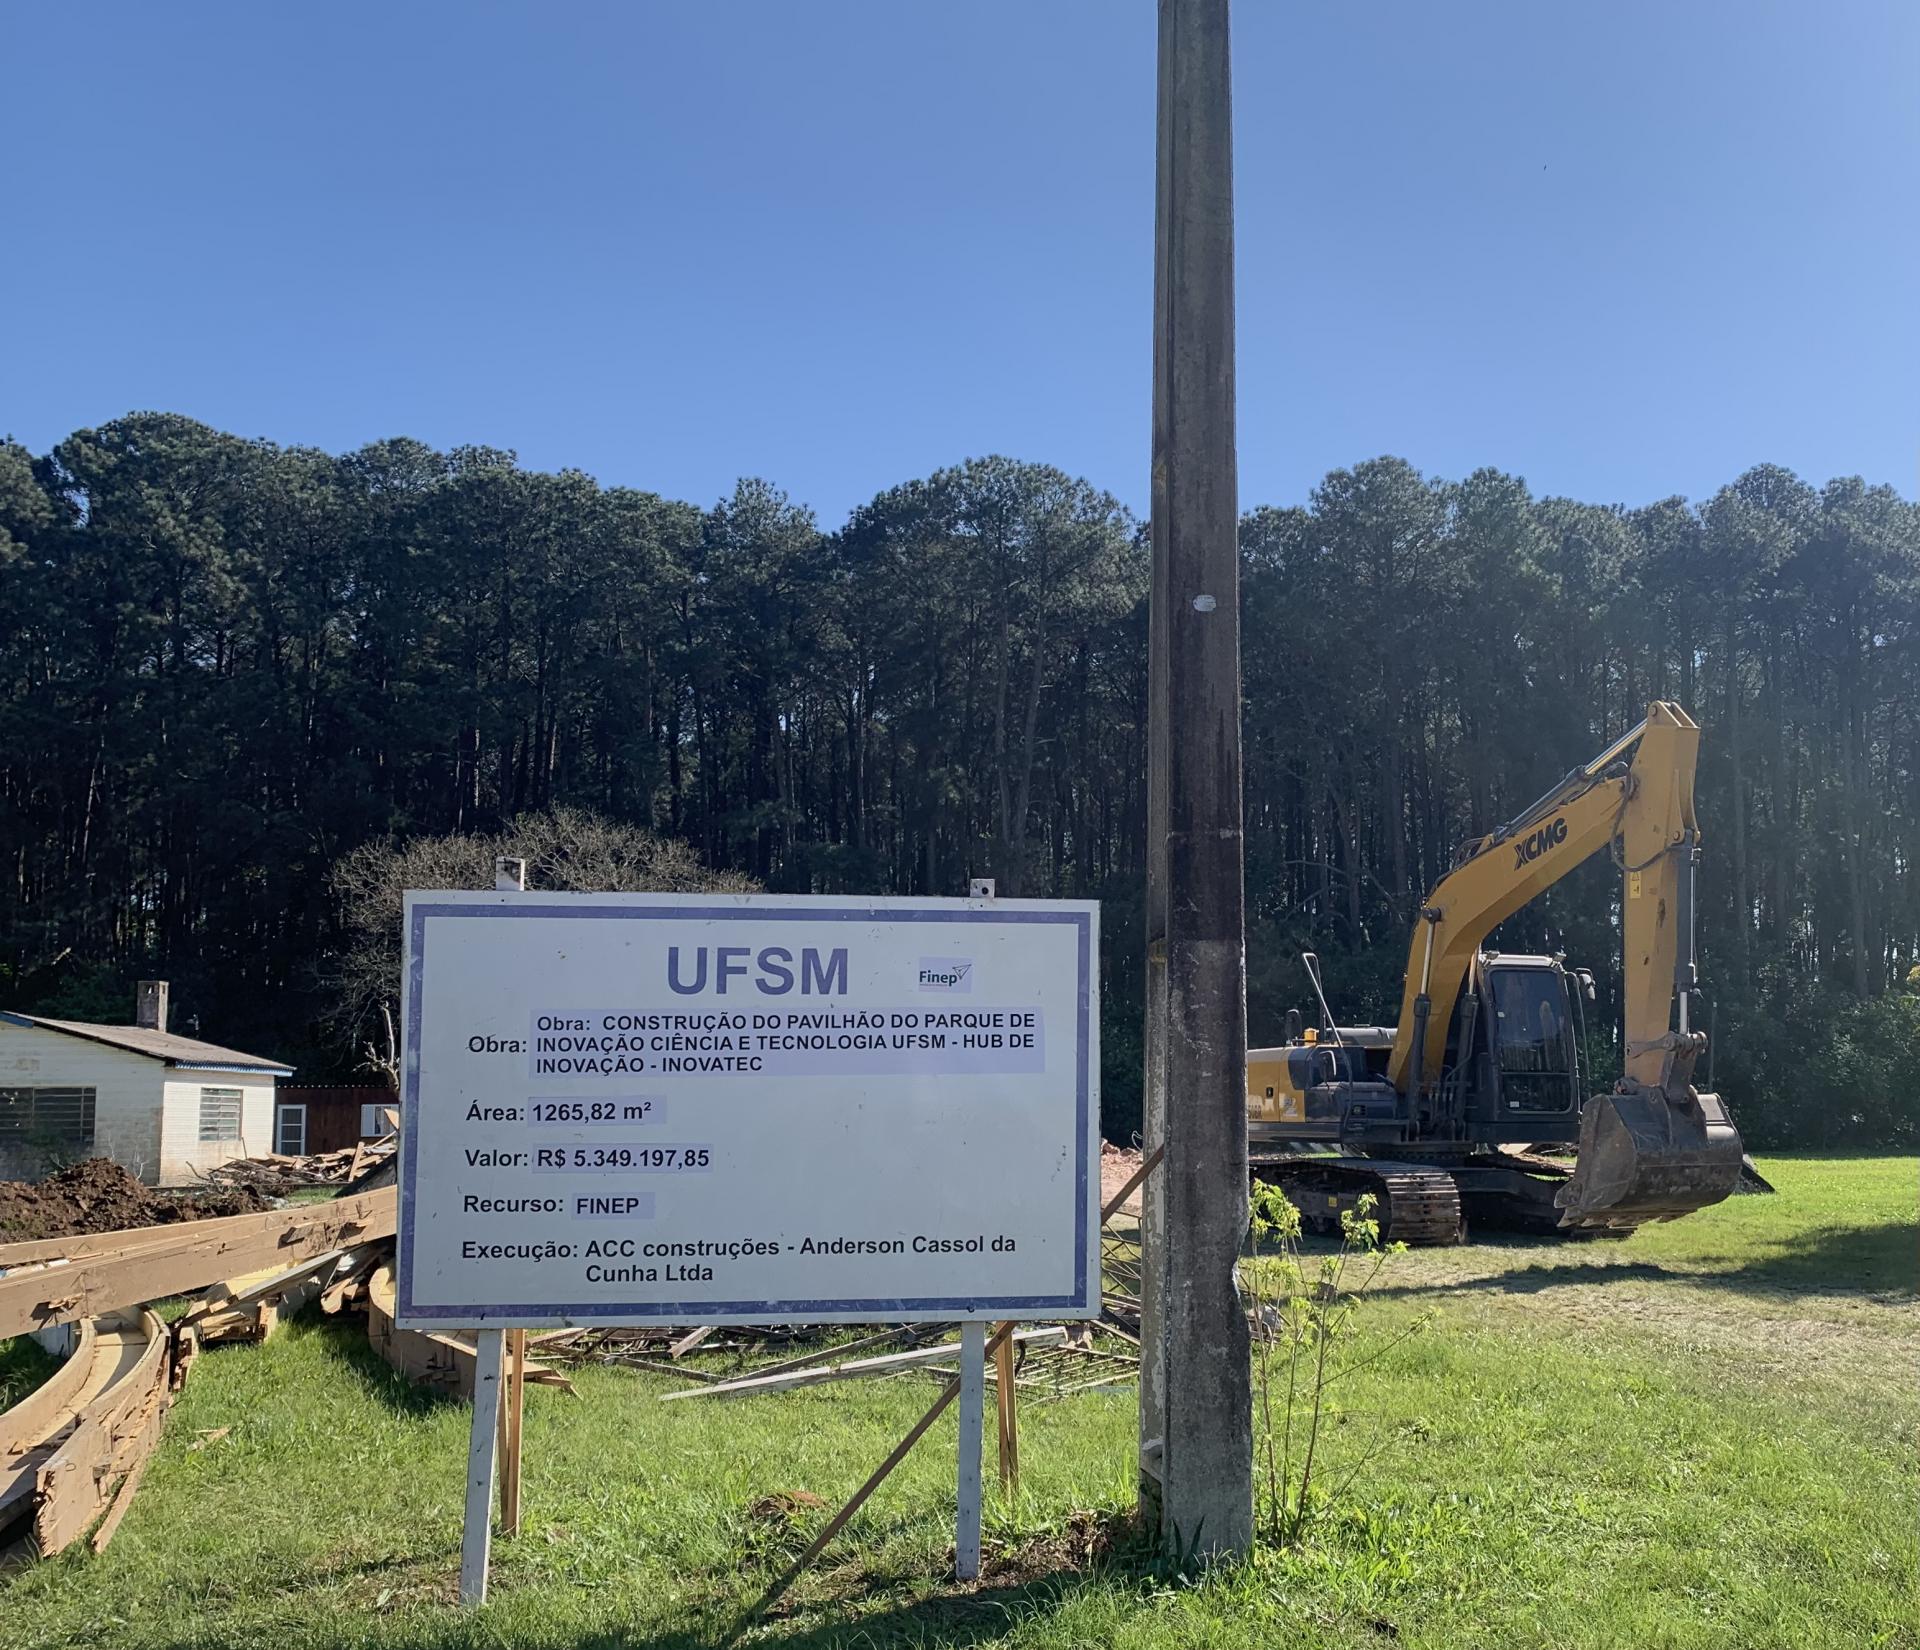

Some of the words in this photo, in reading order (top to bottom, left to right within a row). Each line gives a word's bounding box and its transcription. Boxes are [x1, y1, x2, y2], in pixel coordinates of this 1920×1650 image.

[1513, 817, 1568, 872] XCMG
[667, 946, 849, 996] UFSM
[919, 969, 958, 987] Finep
[537, 1016, 591, 1032] Obra:
[602, 1011, 747, 1034] CONSTRUÇÃO
[752, 1014, 781, 1030] DO
[787, 1010, 885, 1030] PAVILHÃO
[890, 1013, 919, 1029] DO
[924, 1013, 1004, 1029] PARQUE
[1009, 1013, 1035, 1028] DE
[468, 1034, 527, 1053] Obra:
[537, 1033, 645, 1055] INOVAÇÃO
[650, 1032, 734, 1052] CIÊNCIA
[738, 1035, 751, 1051] E
[755, 1034, 888, 1051] TECNOLOGIA
[892, 1034, 946, 1050] UFSM
[963, 1033, 1004, 1049] HUB
[1009, 1033, 1035, 1048] DE
[536, 1054, 645, 1077] INOVAÇÃO
[662, 1056, 763, 1073] INOVATEC
[465, 1099, 525, 1122] Área:
[532, 1102, 616, 1124] 1265,82
[623, 1101, 652, 1121] m²
[464, 1149, 528, 1167] Valor:
[537, 1148, 566, 1169] R$
[573, 1149, 710, 1171] 5.349.197,85
[463, 1195, 564, 1213] Recurso:
[576, 1197, 640, 1215] FINEP
[462, 1240, 578, 1263] Execução:
[584, 1239, 635, 1258] ACC
[642, 1238, 780, 1261] construções
[799, 1236, 905, 1255] Anderson
[912, 1235, 984, 1254] Cassol
[991, 1234, 1016, 1253] da
[586, 1264, 658, 1283] Cunha
[665, 1263, 713, 1282] Ltda
